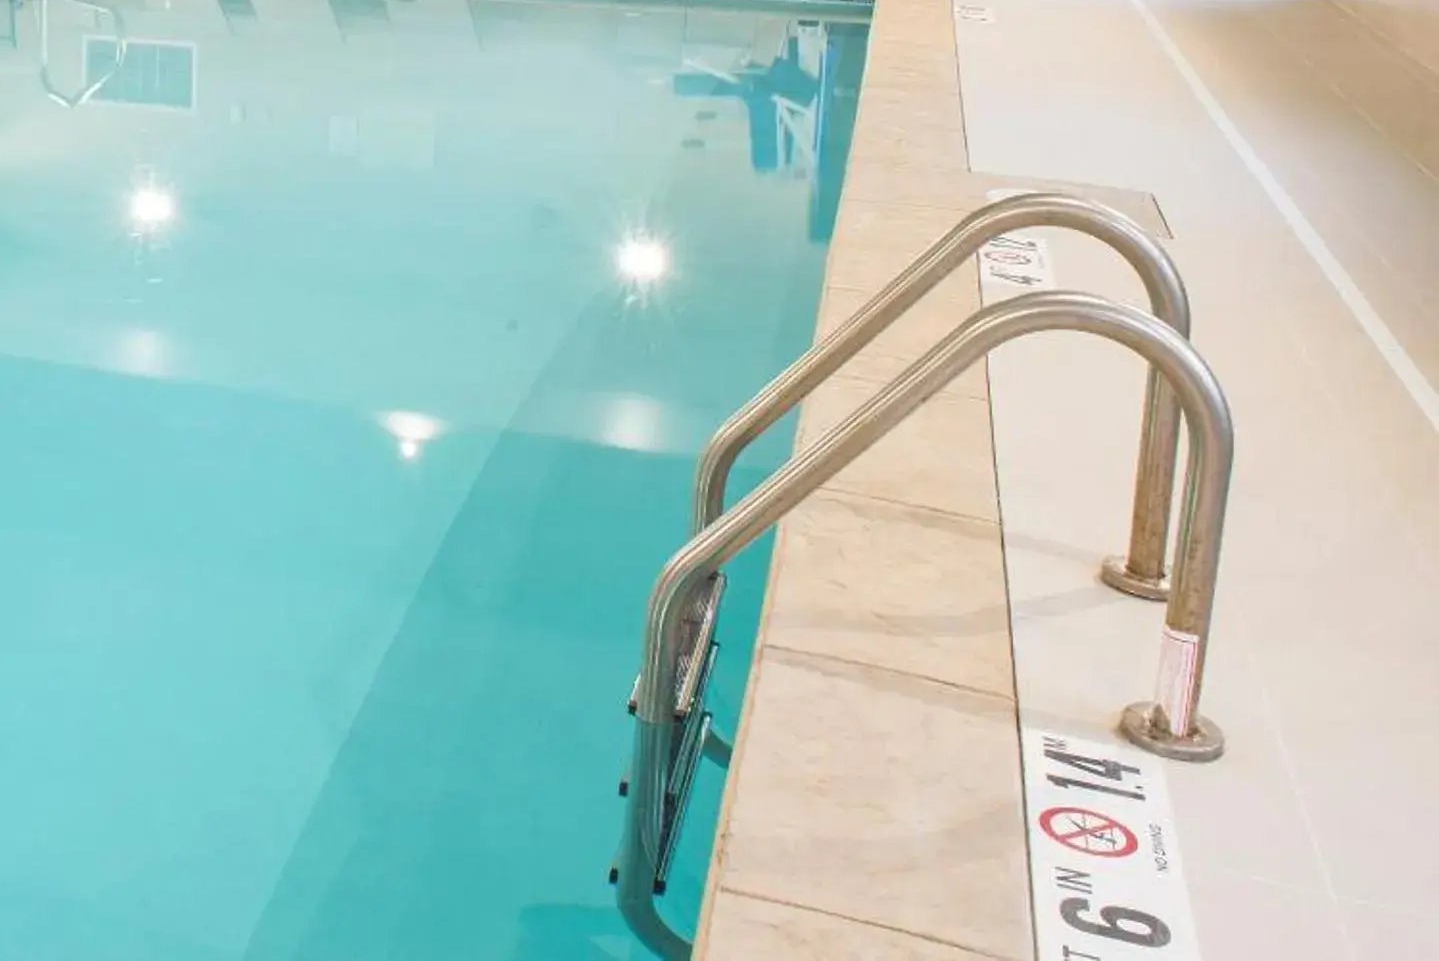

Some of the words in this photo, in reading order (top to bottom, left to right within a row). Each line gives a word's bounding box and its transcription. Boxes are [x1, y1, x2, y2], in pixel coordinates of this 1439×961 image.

[1044, 749, 1147, 802] 1.4
[1054, 866, 1094, 895] IN
[1059, 896, 1172, 949] 6
